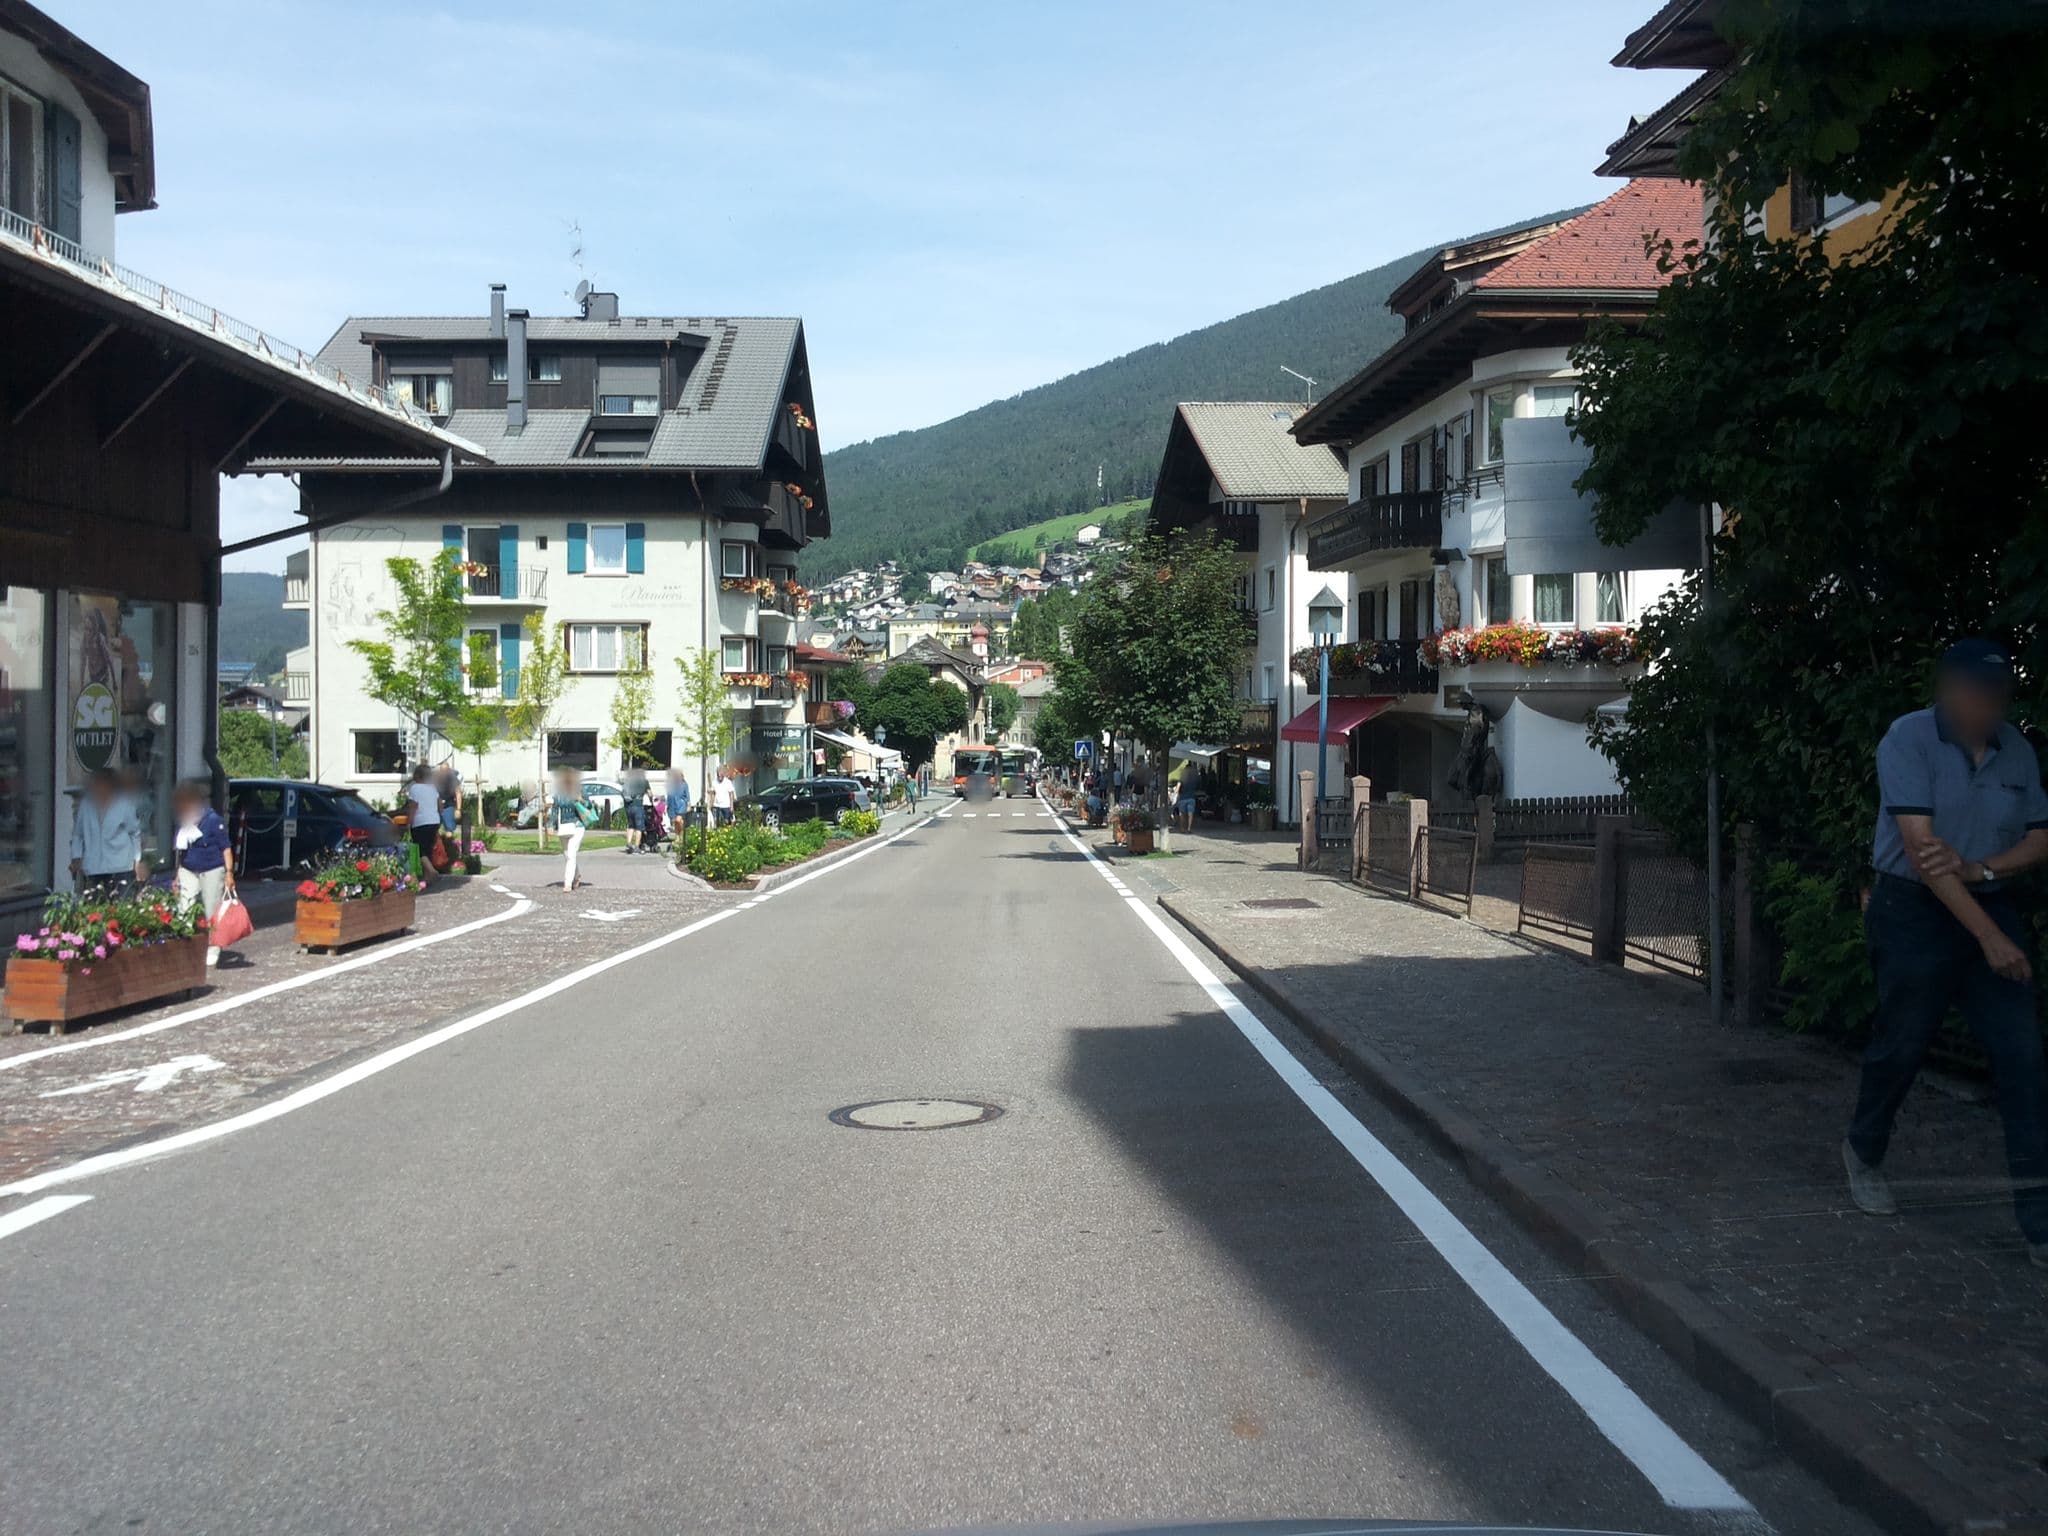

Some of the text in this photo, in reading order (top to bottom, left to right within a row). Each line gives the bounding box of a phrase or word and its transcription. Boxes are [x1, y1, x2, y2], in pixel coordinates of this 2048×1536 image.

[77, 695, 113, 728] SG
[76, 732, 113, 747] OUTLET
[763, 729, 783, 737] Hotel
[287, 789, 296, 816] P
